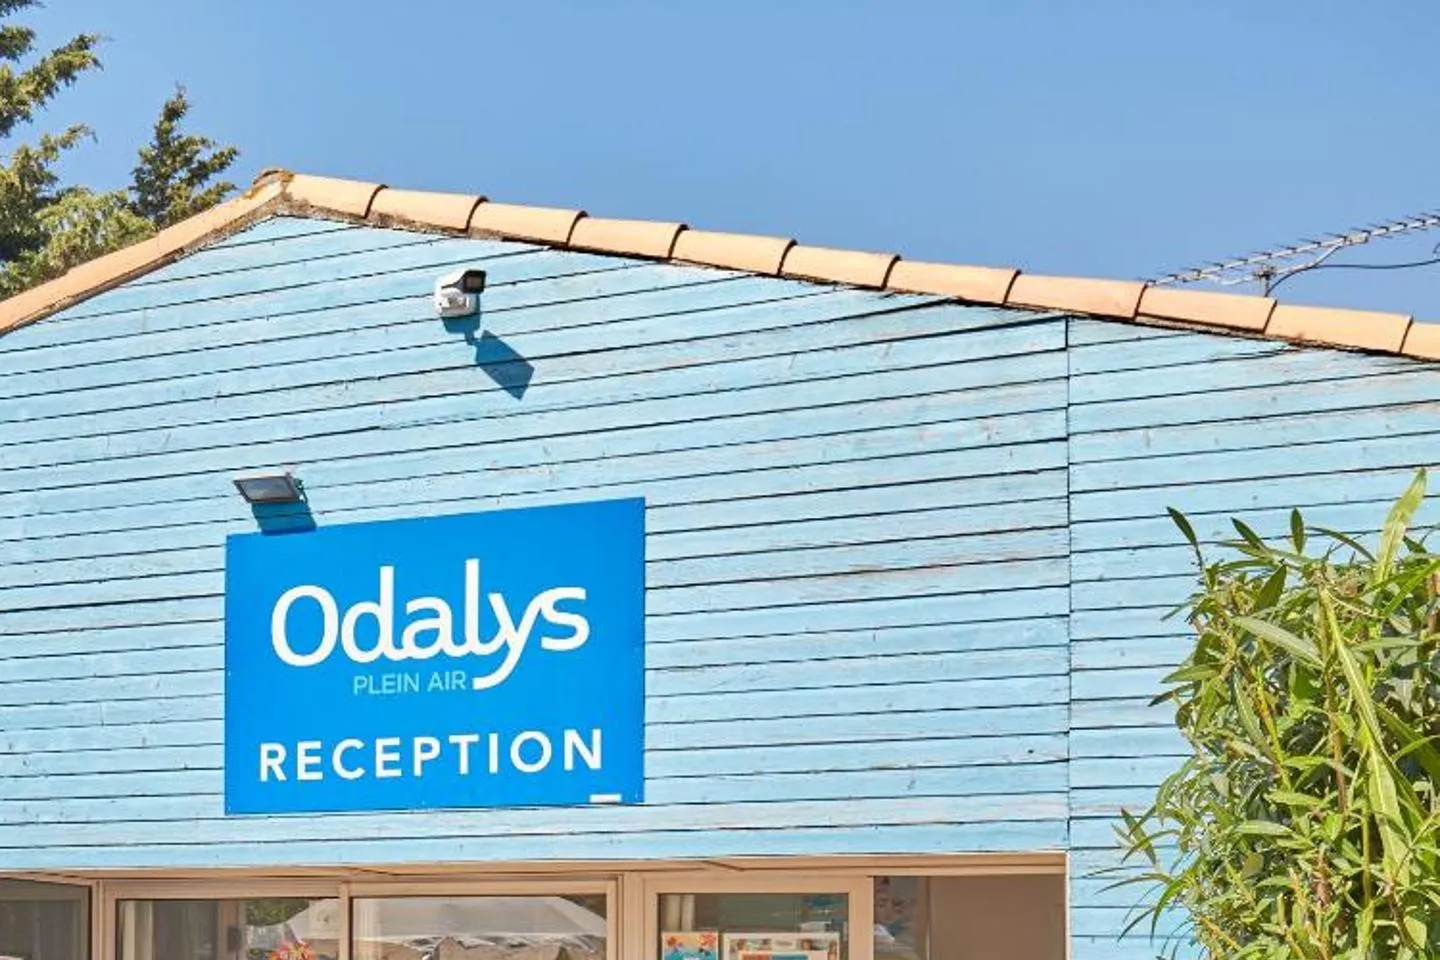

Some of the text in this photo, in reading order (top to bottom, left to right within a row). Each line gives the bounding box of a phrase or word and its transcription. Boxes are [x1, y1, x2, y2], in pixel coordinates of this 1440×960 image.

[271, 558, 590, 690] Odalys
[353, 670, 466, 696] PLEIN AIR
[261, 728, 602, 782] RECEPTION
